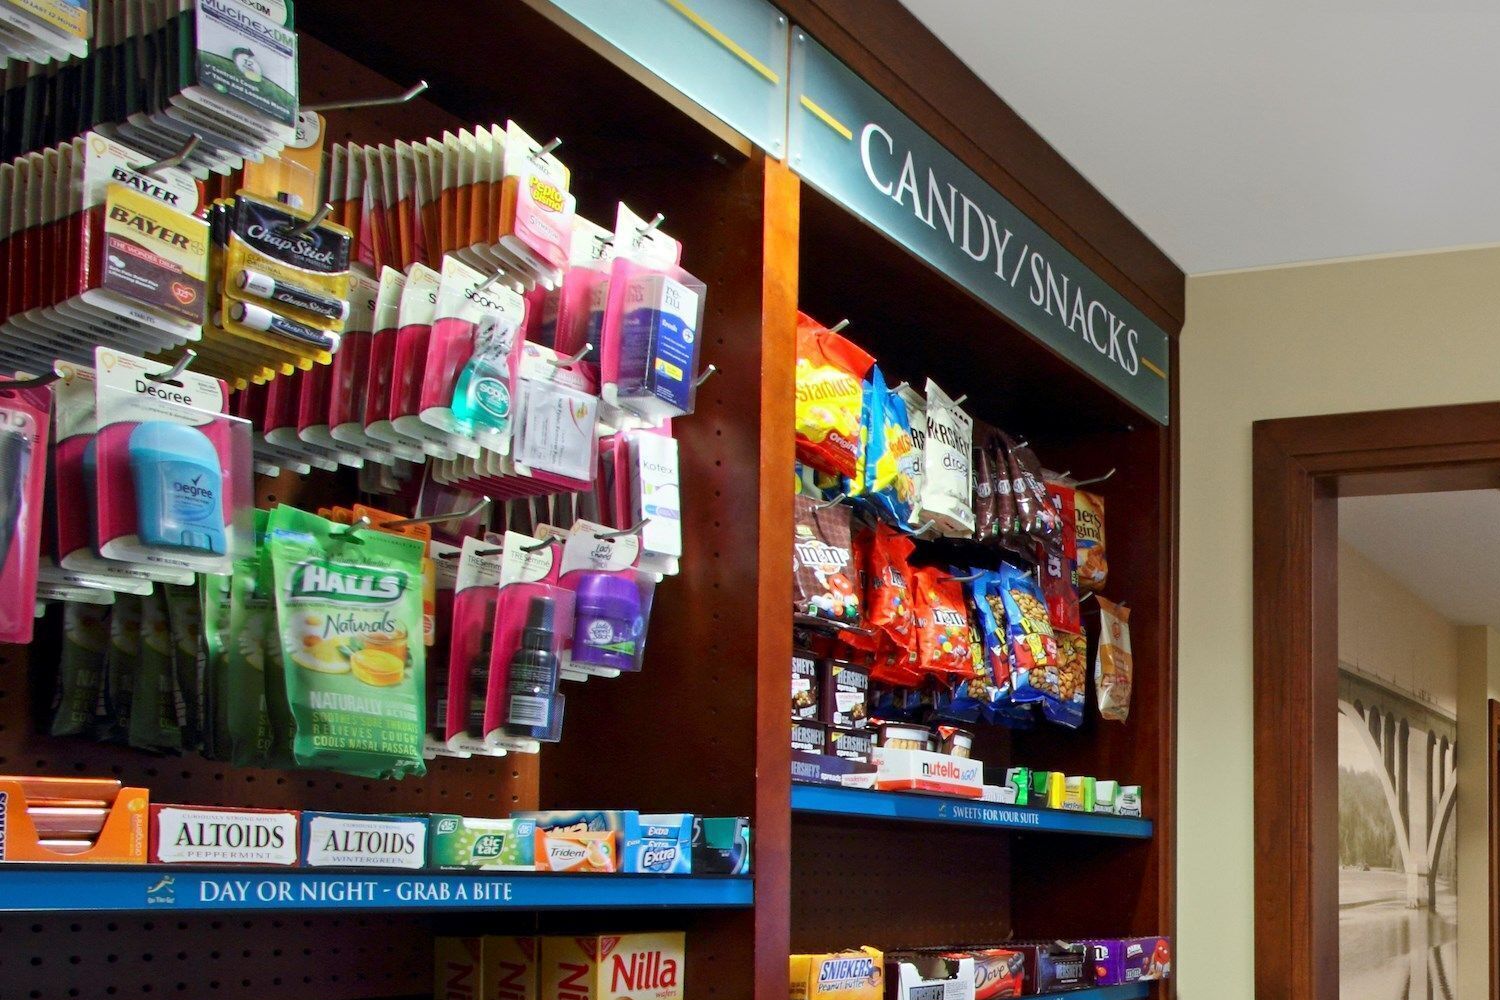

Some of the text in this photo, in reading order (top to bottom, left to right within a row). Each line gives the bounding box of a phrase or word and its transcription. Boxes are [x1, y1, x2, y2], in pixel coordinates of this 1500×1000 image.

[112, 168, 179, 206] BAYER
[528, 175, 564, 201] Pepto
[109, 207, 190, 250] BAYER
[112, 239, 126, 250] THE
[247, 224, 335, 266] ChapStick
[860, 123, 1138, 376] CANDY/SNACKS
[278, 293, 333, 317] ChapStick
[643, 460, 674, 474] Kotex
[174, 482, 213, 500] Degree
[302, 564, 399, 599] HALLS
[323, 610, 396, 639] Naturals
[310, 690, 384, 715] NATURALLY
[313, 723, 373, 739] RELIEVES
[313, 735, 379, 751] COOLS NASAL
[922, 762, 960, 780] nutella
[182, 813, 278, 823] CURIOUSLY STRONG MINTS
[953, 806, 1040, 825] SWEETS FOR YOUR SUITE
[175, 822, 285, 849] ALTOIDS
[648, 825, 669, 837] Extra
[324, 830, 415, 855] ALTOIDS
[477, 844, 499, 855] tac
[482, 835, 501, 847] tic
[187, 850, 272, 860] PEPPERMINT
[332, 855, 404, 865] WINTERGREEN
[550, 847, 586, 859] Trident
[643, 847, 676, 866] Extra
[200, 881, 251, 902] DAY
[257, 881, 293, 902] OR
[301, 882, 378, 901] NIGHT
[397, 881, 450, 901] GRAB
[455, 882, 468, 900] A
[473, 882, 513, 901] BITE
[611, 951, 677, 993] Nilla
[820, 958, 873, 981] SNICKERS
[655, 988, 677, 1000] wafers
